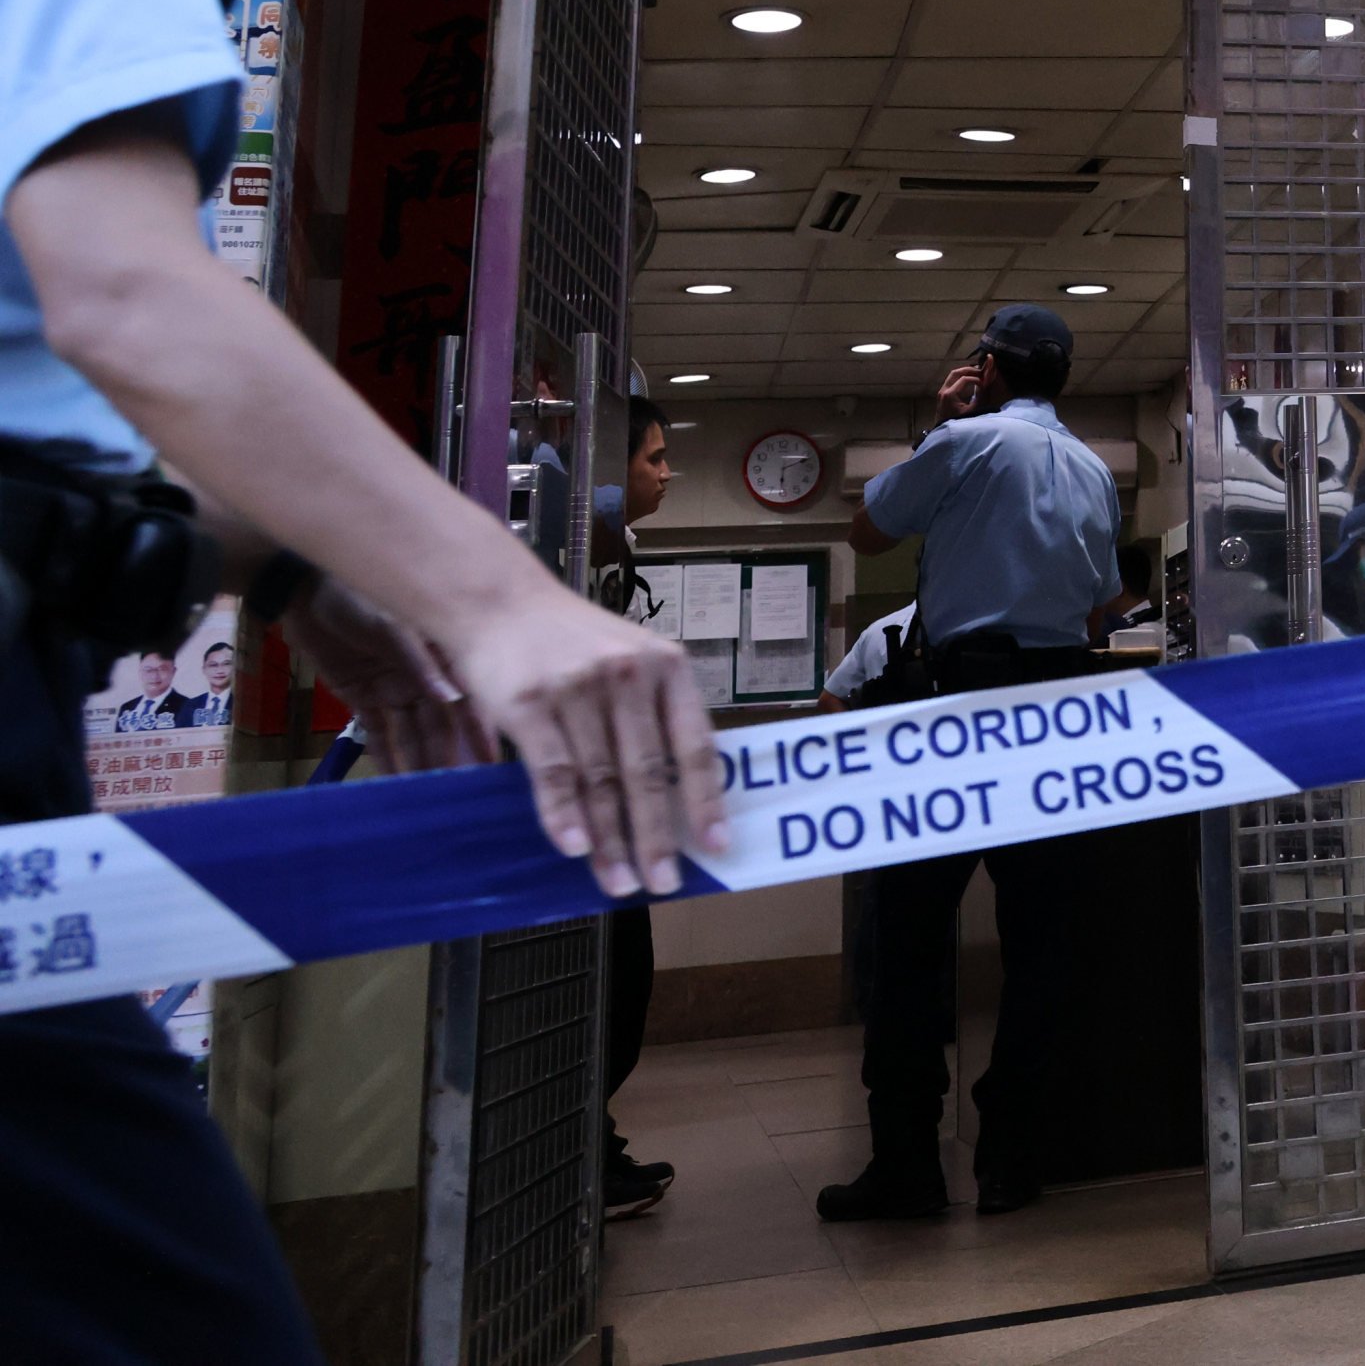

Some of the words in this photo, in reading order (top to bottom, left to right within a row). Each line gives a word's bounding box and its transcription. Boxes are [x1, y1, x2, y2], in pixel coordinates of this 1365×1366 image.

[780, 802, 866, 861] DO
[881, 781, 998, 844] NOT
[1032, 742, 1226, 816] CROSS
